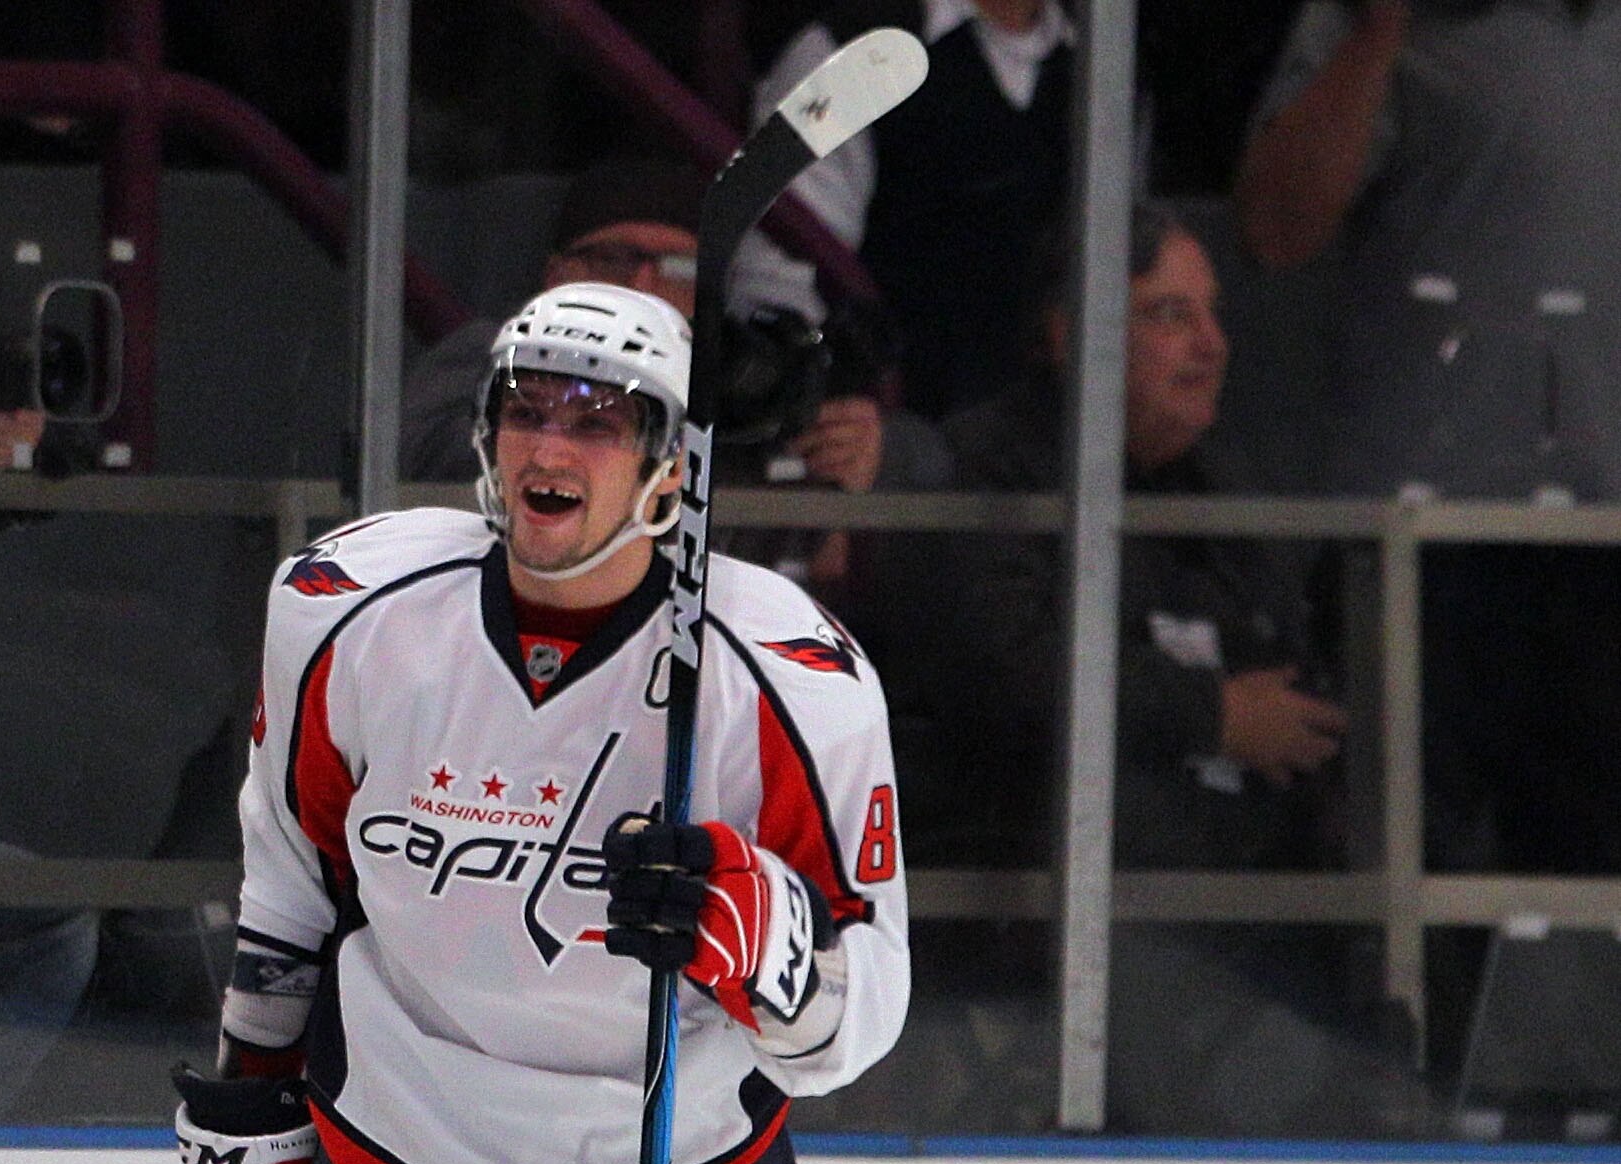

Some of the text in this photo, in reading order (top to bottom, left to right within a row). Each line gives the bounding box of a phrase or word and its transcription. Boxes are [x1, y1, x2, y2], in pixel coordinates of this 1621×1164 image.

[543, 325, 608, 343] CCM
[671, 422, 714, 668] CCM
[409, 793, 555, 830] WASHINGTON
[856, 784, 896, 884] 8
